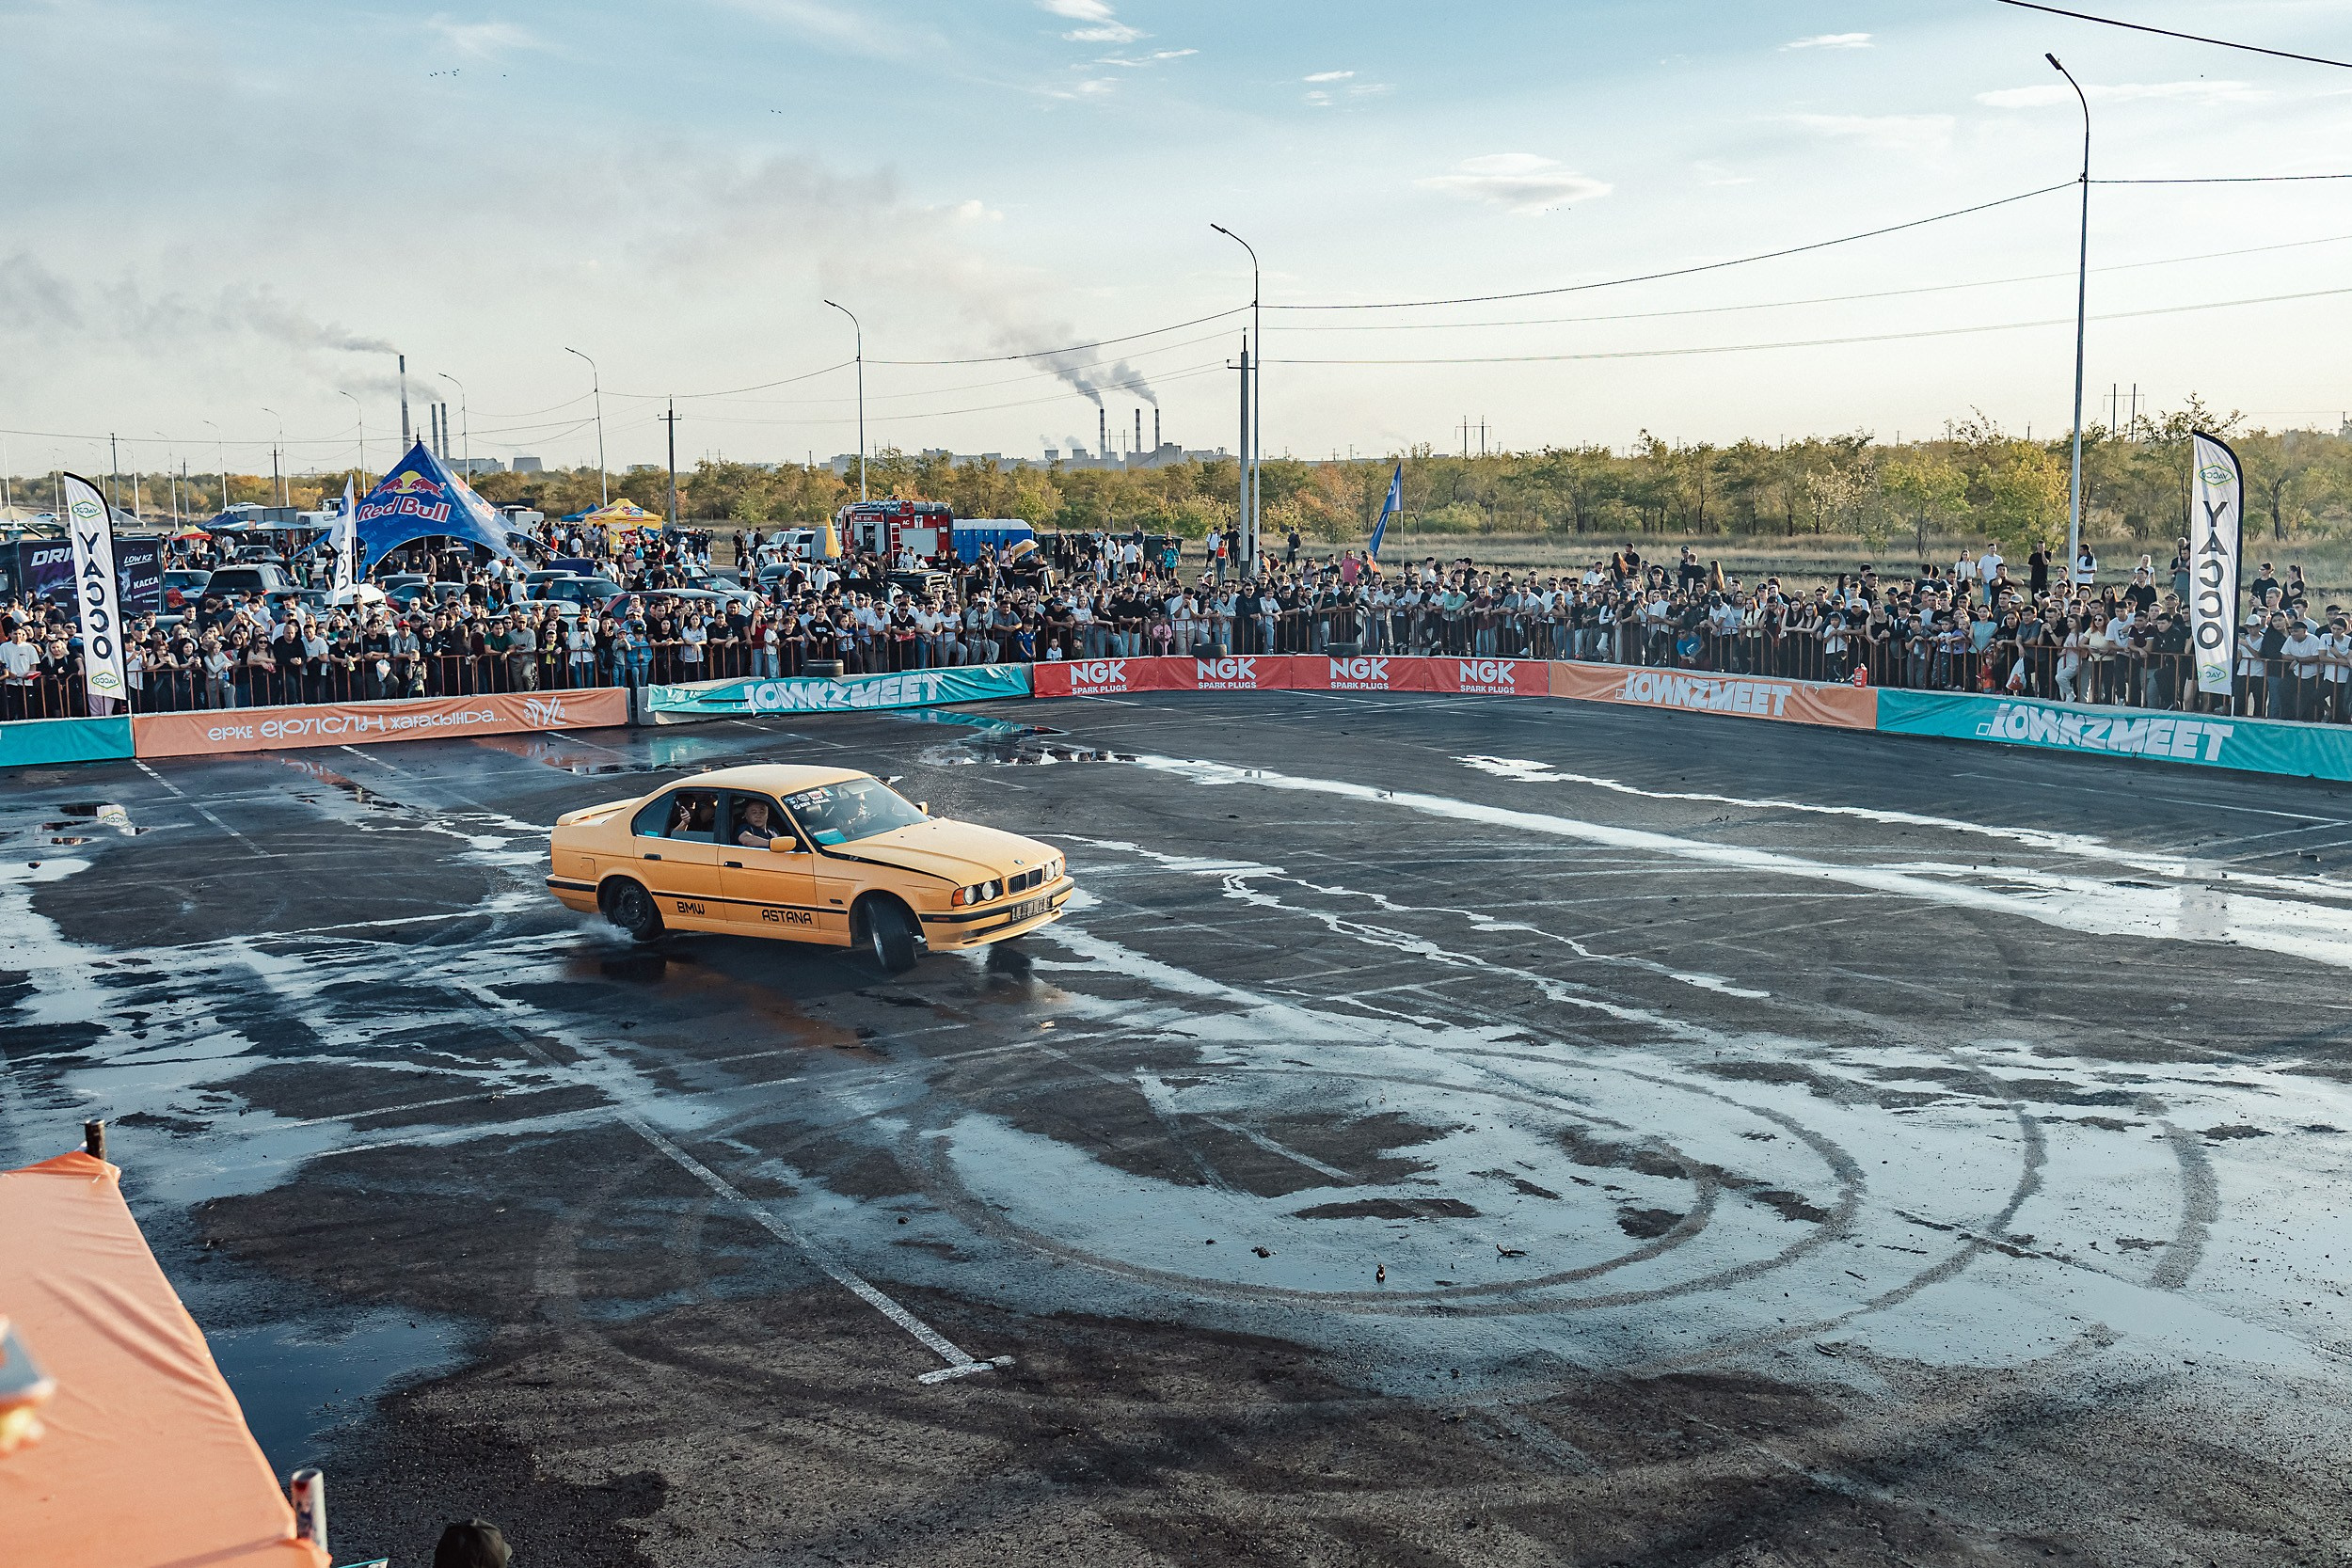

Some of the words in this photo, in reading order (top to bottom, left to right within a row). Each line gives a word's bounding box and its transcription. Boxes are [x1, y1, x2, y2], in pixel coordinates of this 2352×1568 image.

[356, 496, 399, 523] Red
[398, 496, 451, 523] Bull
[31, 547, 73, 567] DRI
[1070, 659, 1127, 686] NGK
[1197, 657, 1257, 680] NGK
[1329, 657, 1390, 681] NGK
[1459, 660, 1516, 685] NGK
[1072, 686, 1099, 695] SPARK
[1100, 684, 1127, 693] PLUGS
[1198, 681, 1227, 689] SPARK
[1330, 681, 1359, 689] SPARK
[1360, 682, 1390, 690] PLUGS
[1460, 684, 1486, 693] SPARK
[1487, 685, 1516, 694] PLUGS
[1624, 672, 1792, 717] LOWKZMEET
[1987, 703, 2234, 762] LOWKZMEET
[676, 901, 706, 915] BMW
[762, 909, 813, 925] ASTANA
